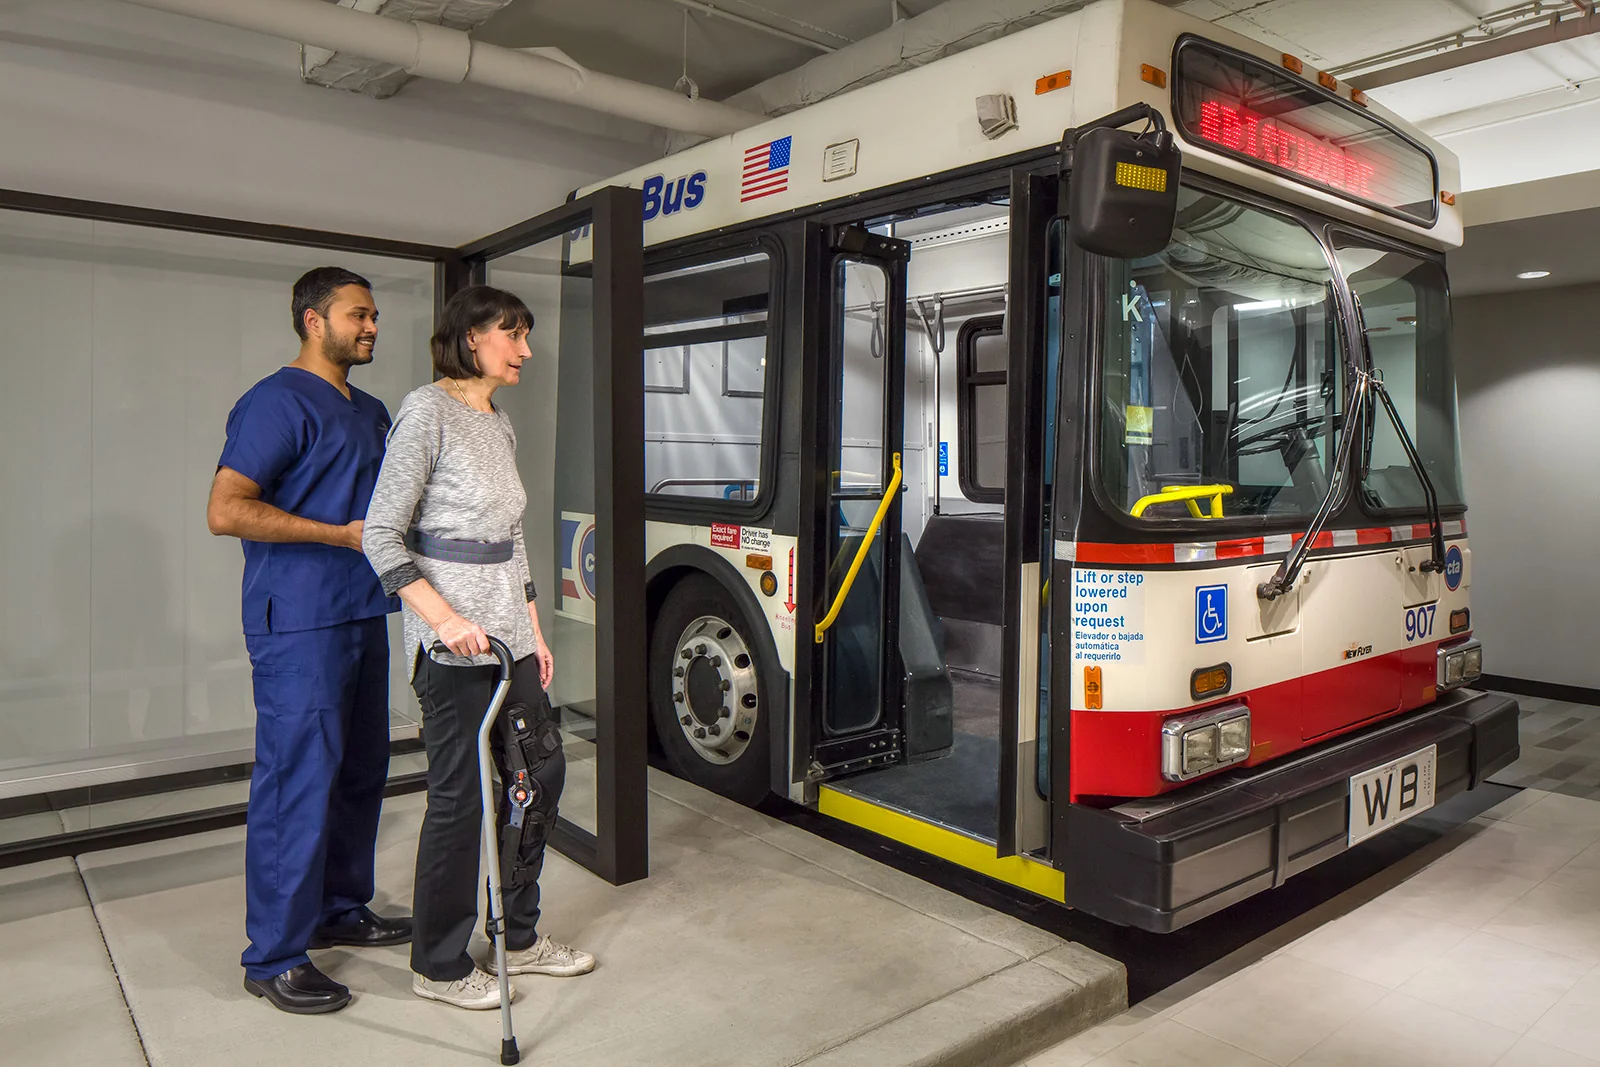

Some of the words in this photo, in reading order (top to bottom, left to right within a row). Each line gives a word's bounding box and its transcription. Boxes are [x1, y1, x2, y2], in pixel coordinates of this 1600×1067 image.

[643, 171, 707, 221] Bus
[1122, 293, 1143, 322] K
[712, 525, 726, 534] Exact
[727, 526, 737, 535] fare
[741, 528, 757, 537] Driver
[758, 530, 769, 539] has
[712, 534, 733, 543] required
[741, 536, 750, 544] NO
[751, 537, 771, 548] change
[1447, 561, 1460, 574] cta
[1075, 570, 1097, 583] Lift
[1100, 573, 1114, 583] or
[1117, 572, 1144, 586] step
[1075, 585, 1127, 598] lowered
[1075, 602, 1108, 615] upon
[1075, 615, 1125, 629] request
[1405, 604, 1436, 642] 907
[1075, 631, 1109, 640] Elevador
[1118, 632, 1144, 642] bajada
[1075, 642, 1119, 650] automática
[1084, 652, 1121, 661] requerirlo
